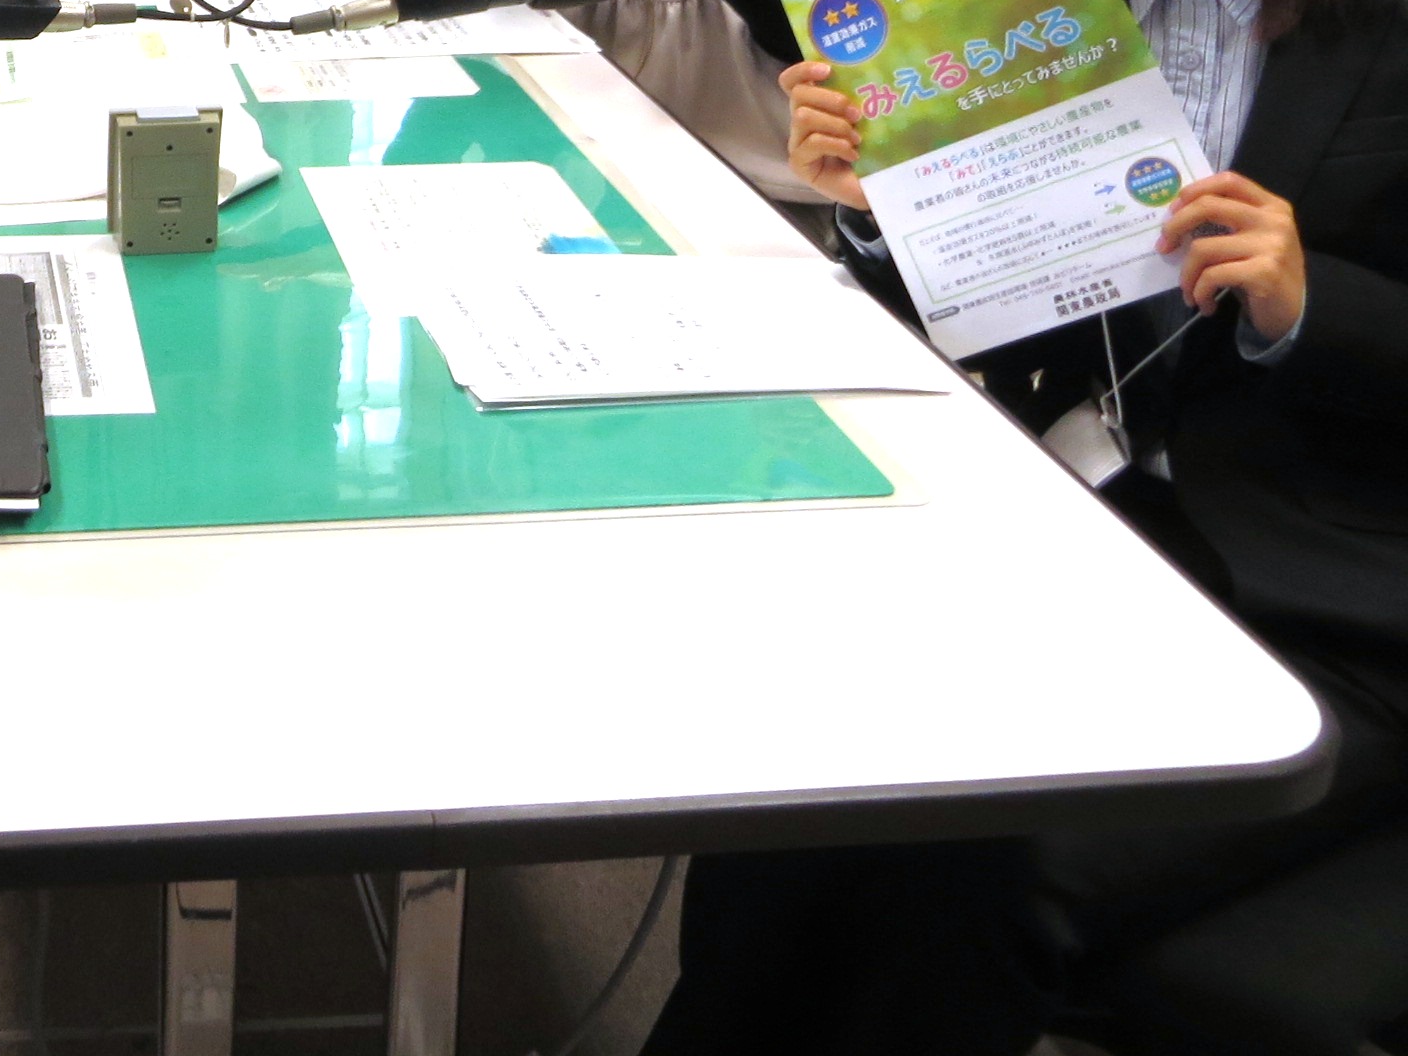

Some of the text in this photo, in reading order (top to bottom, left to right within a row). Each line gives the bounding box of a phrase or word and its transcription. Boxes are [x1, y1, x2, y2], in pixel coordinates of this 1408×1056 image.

[820, 17, 879, 48] 温室効果ガス
[856, 6, 1082, 121] みえるらべる
[956, 37, 1119, 112] を手にとってみませんか？
